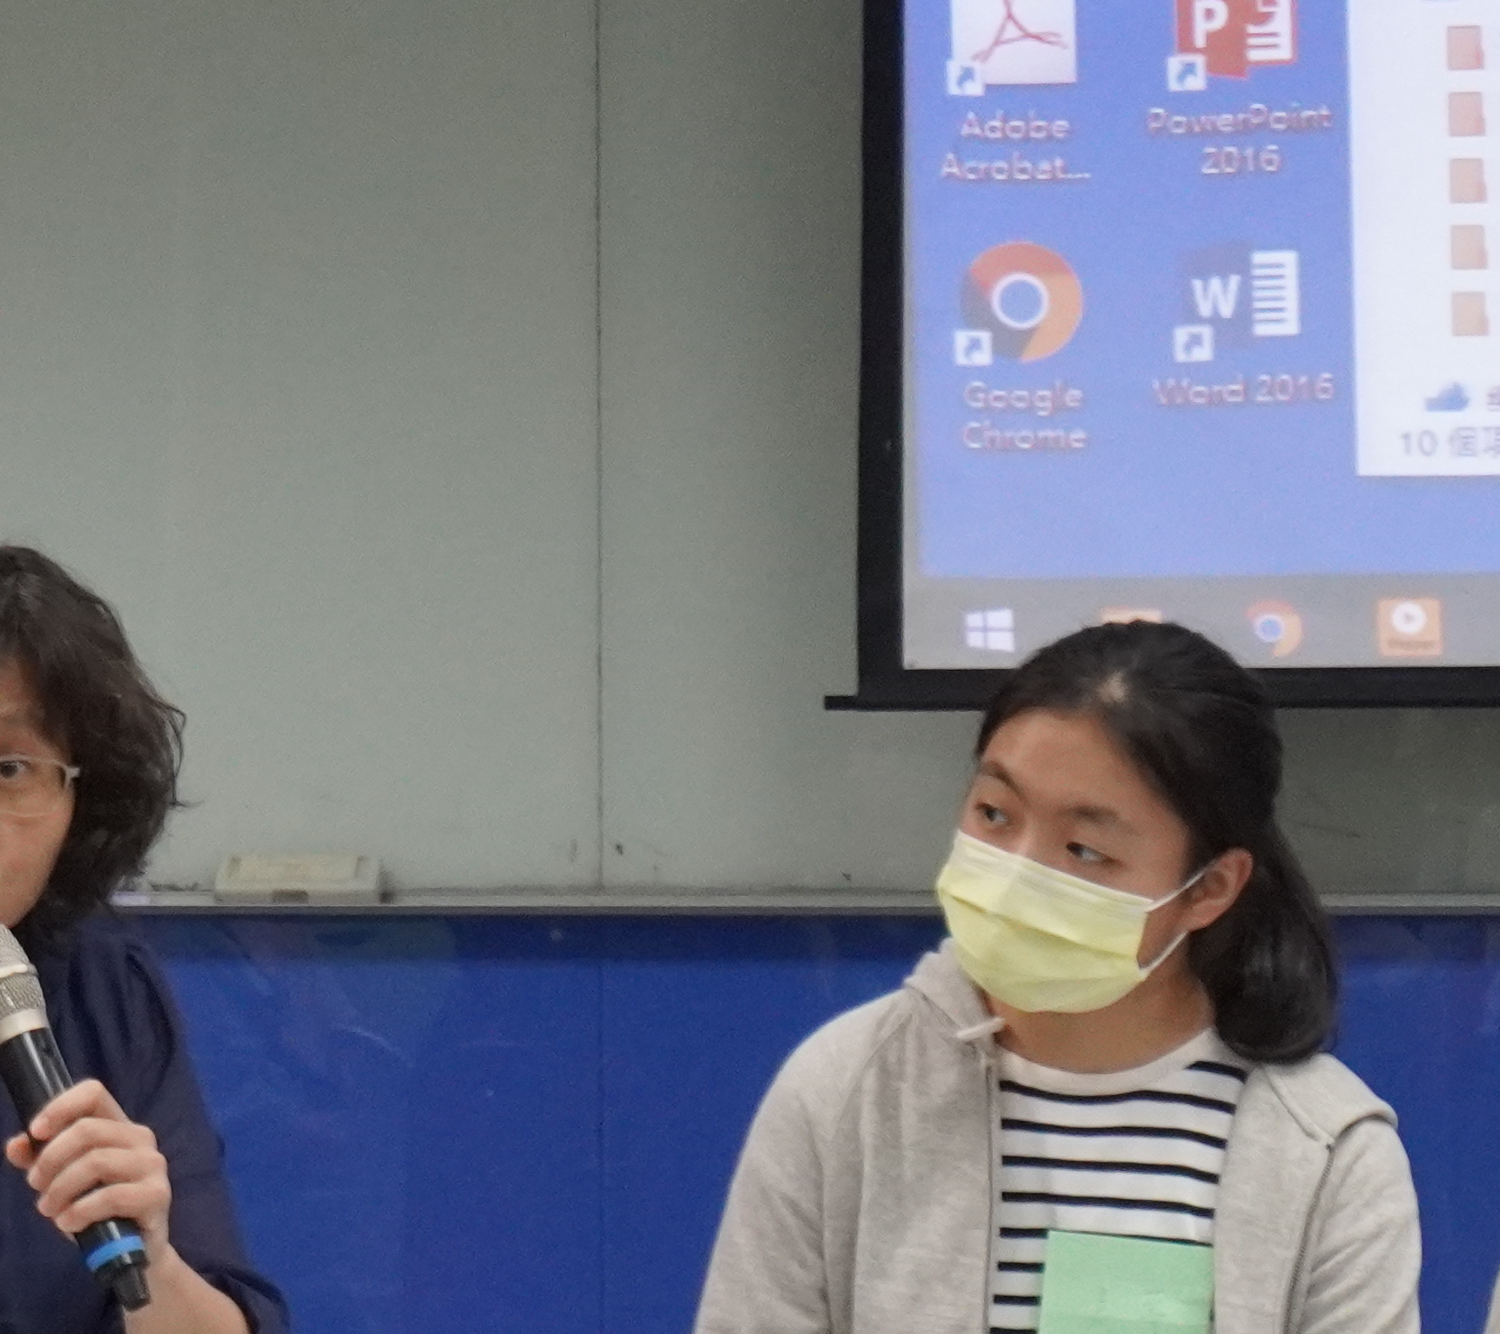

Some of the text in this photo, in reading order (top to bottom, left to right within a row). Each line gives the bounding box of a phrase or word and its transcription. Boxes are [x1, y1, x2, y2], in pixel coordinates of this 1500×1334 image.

[960, 109, 1070, 139] Adobe
[1148, 103, 1332, 134] PowerPoint
[1201, 145, 1281, 176] 2016
[964, 379, 1083, 418] Google
[1152, 372, 1334, 406] Word 2016
[963, 421, 1088, 451] Chrome
[1400, 429, 1438, 457] 10
